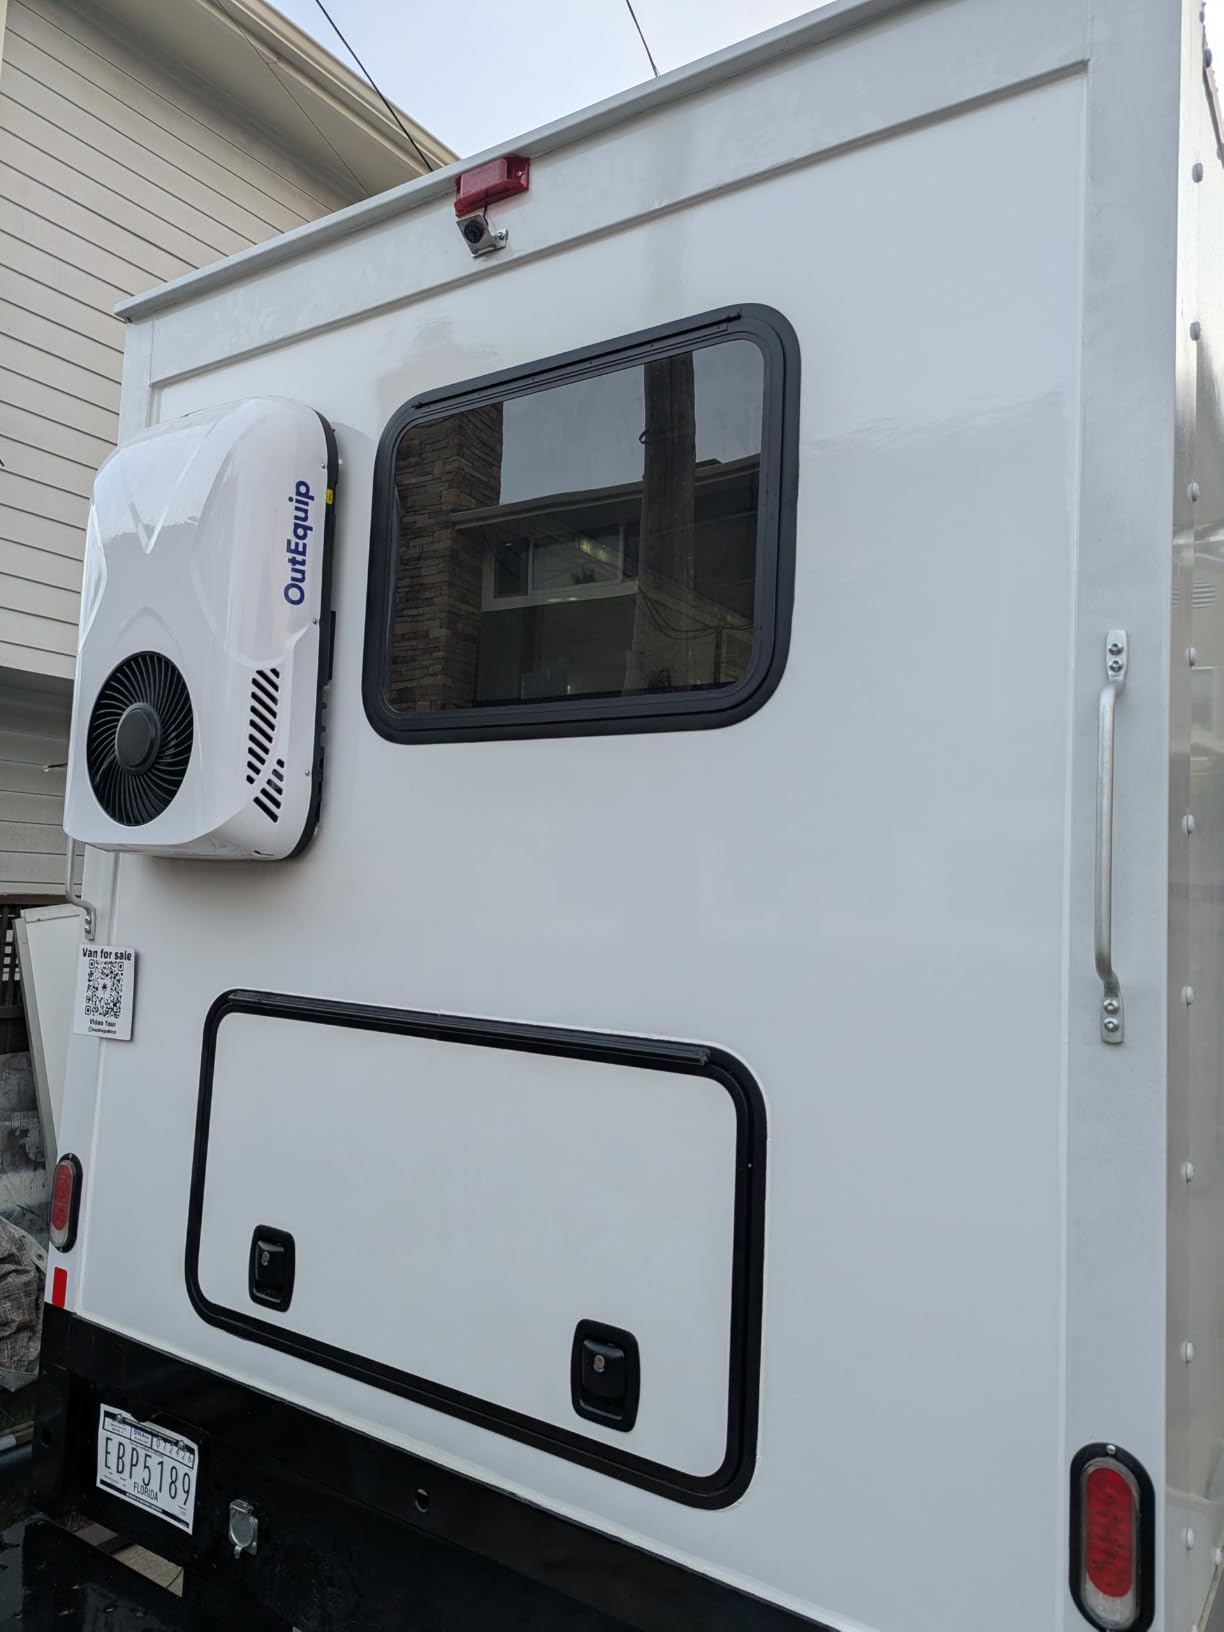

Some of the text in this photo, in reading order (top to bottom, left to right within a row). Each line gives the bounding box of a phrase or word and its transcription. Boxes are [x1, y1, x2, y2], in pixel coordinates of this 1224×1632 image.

[283, 480, 315, 606] OutEquip
[82, 947, 132, 961] Van for sale
[89, 1018, 104, 1026] Video
[104, 1436, 191, 1506] EBP5189
[133, 1481, 159, 1503] FLORIDA
